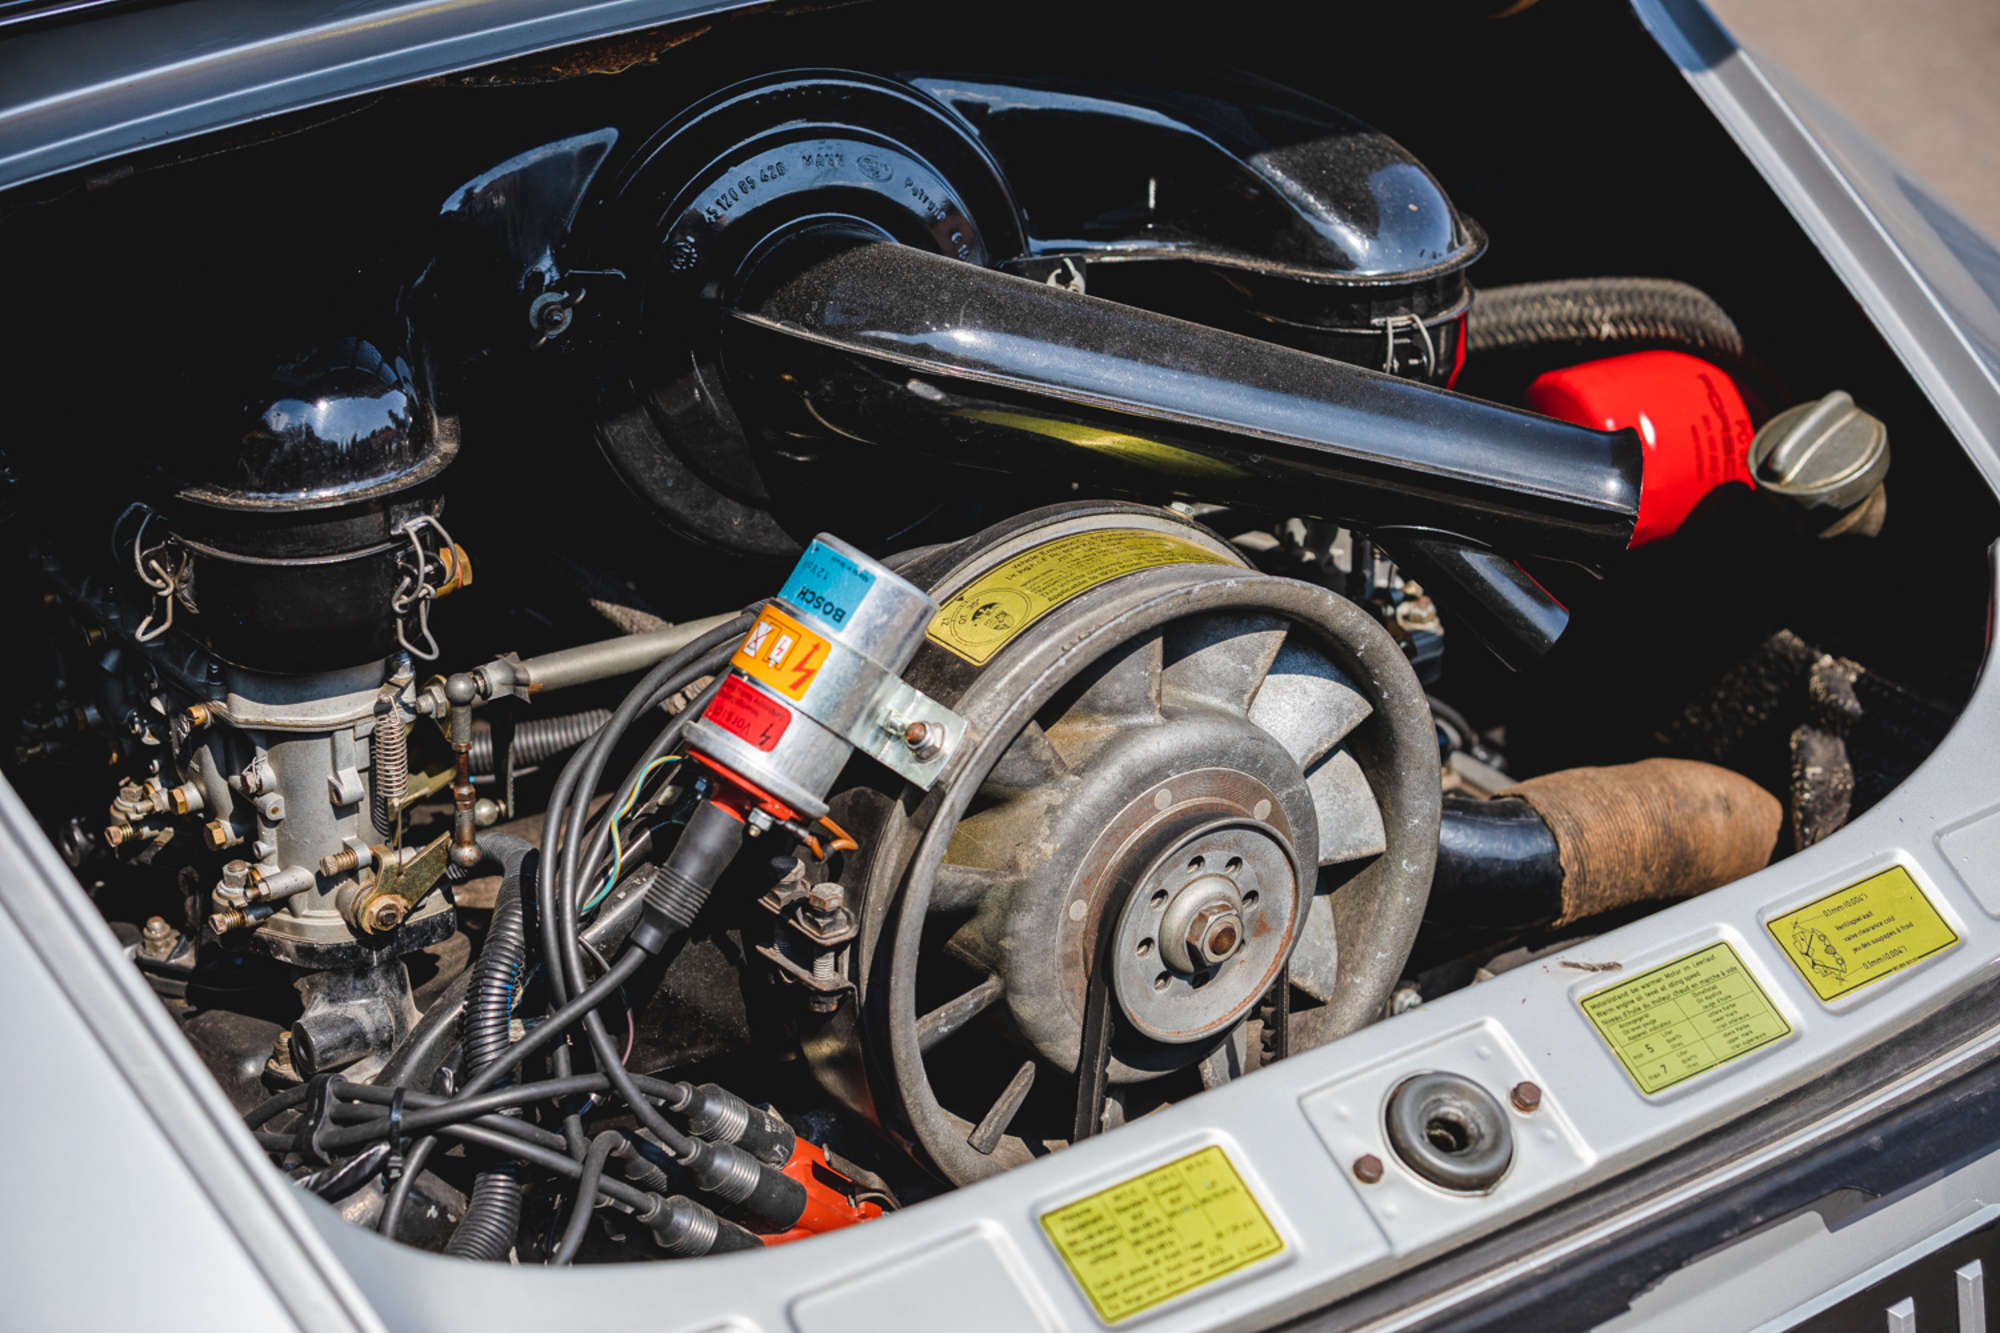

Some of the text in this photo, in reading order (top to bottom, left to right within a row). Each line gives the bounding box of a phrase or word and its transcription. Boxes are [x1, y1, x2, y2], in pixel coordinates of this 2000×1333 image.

[716, 187, 739, 212] 120
[797, 586, 846, 623] BOSCH
[1663, 968, 1681, 978] Motor
[1643, 1042, 1655, 1054] 5
[1659, 1063, 1670, 1074] 7
